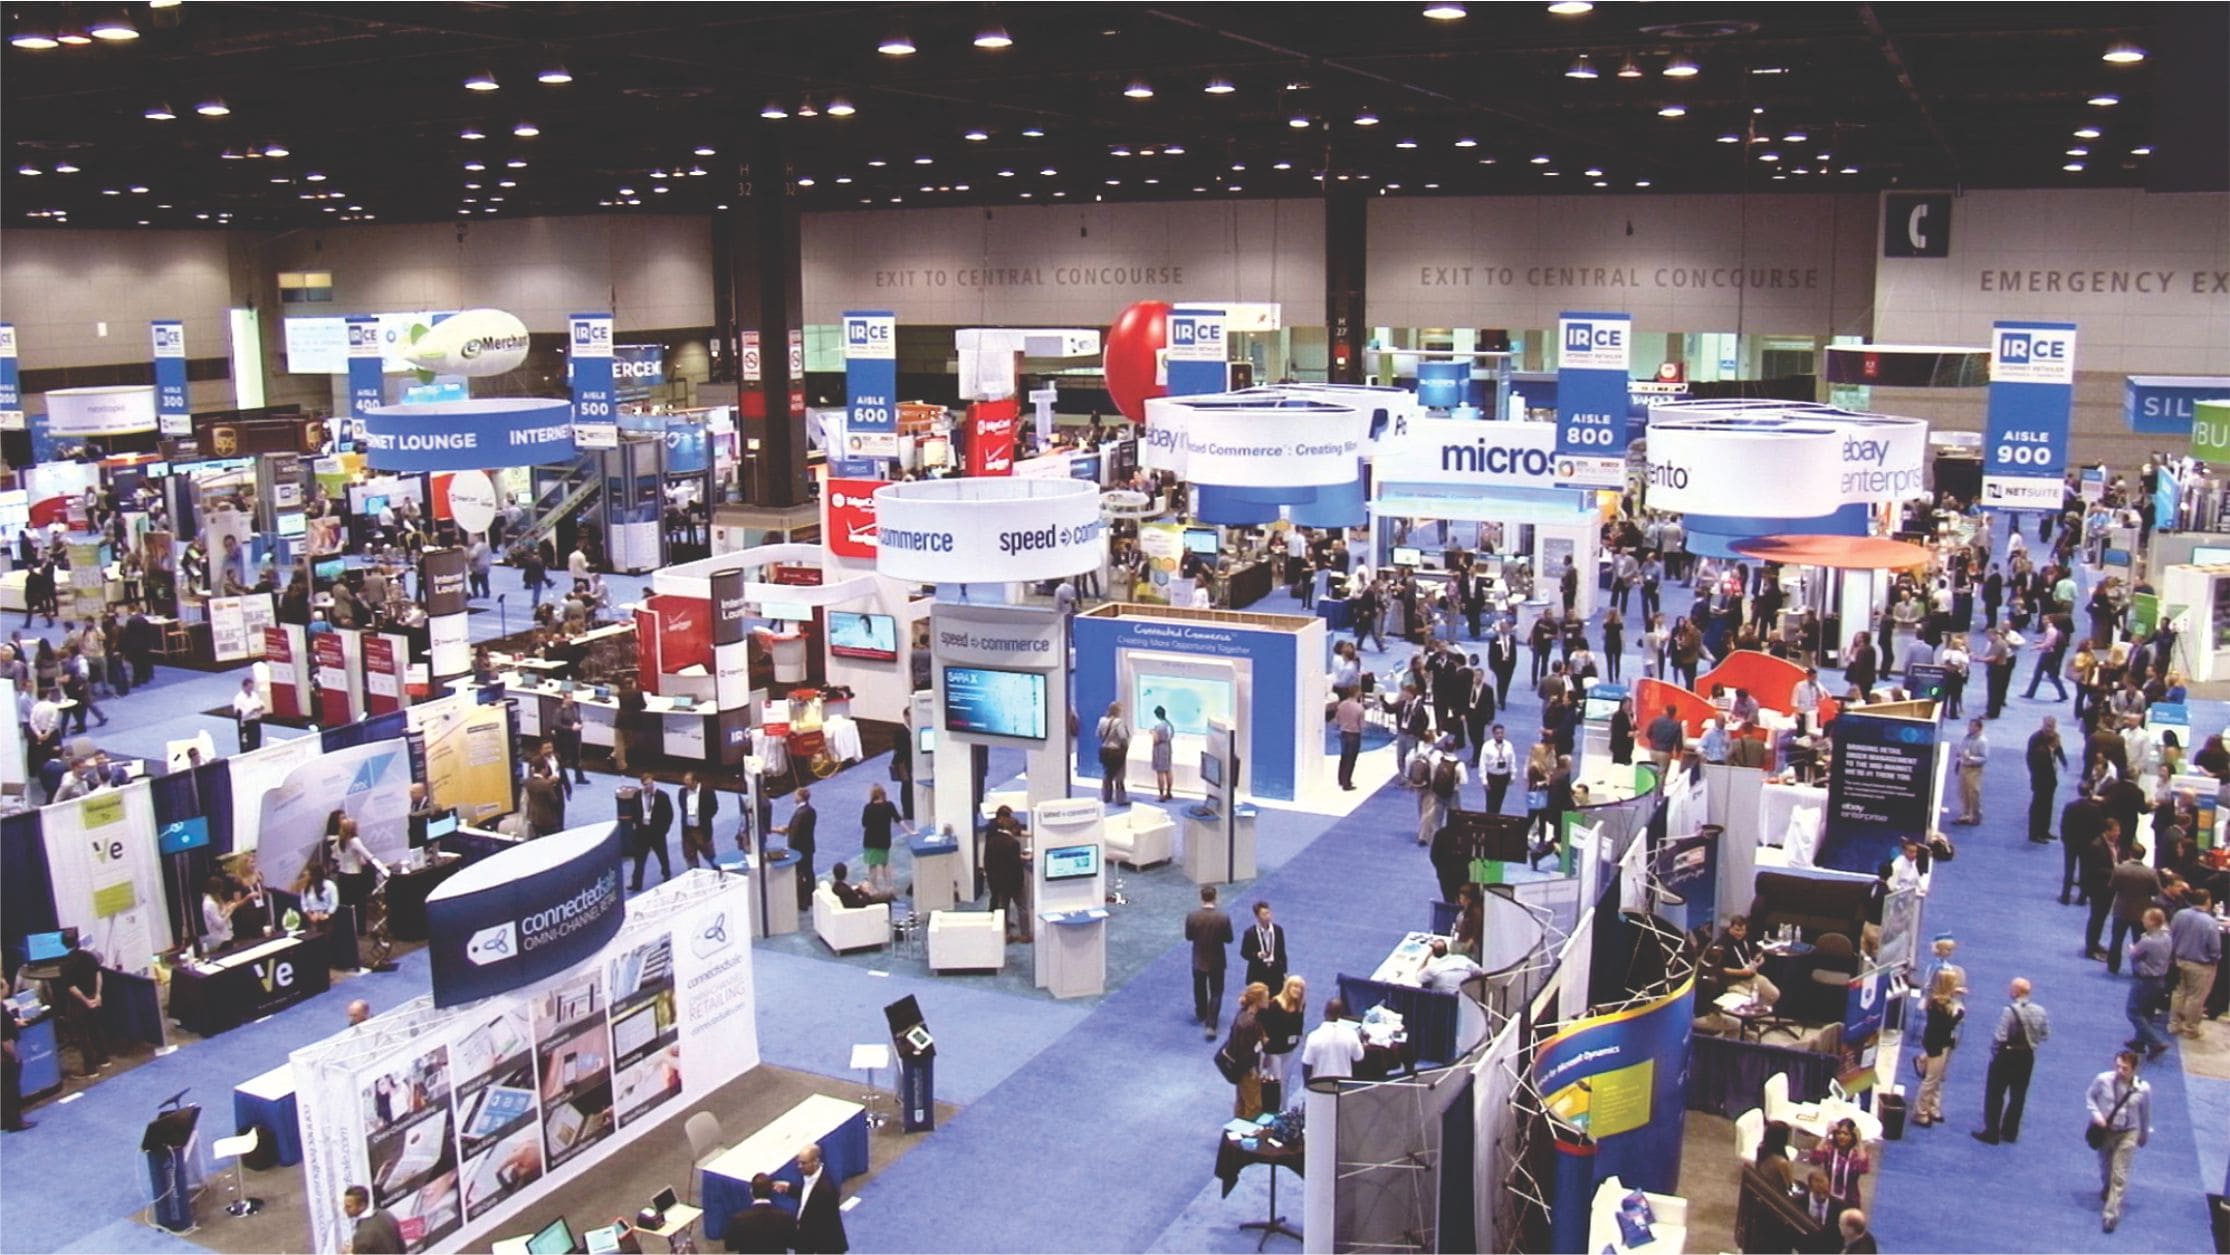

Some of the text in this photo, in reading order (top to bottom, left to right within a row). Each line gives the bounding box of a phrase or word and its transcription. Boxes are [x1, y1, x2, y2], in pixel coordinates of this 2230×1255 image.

[876, 266, 1184, 288] EXIT TO CENTRAL CONCOURSE
[1421, 267, 1819, 289] EXIT TO CENTRAL CONCOURSE
[1980, 270, 2175, 293] EMERGENCY
[575, 323, 608, 344] IRCE
[849, 321, 888, 344] IRCE
[1173, 320, 1221, 344] IRCE
[1566, 325, 1623, 350] IRCE
[2000, 335, 2065, 362] IRCE
[163, 396, 184, 407] 300
[583, 392, 606, 400] AISLE
[856, 396, 886, 406] AISLE
[581, 403, 609, 416] 500
[853, 408, 888, 424] 600
[1571, 413, 1611, 425] AISLE
[400, 432, 478, 450] LOUNGE
[1566, 427, 1614, 445] 800
[2003, 430, 2049, 443] AISLE
[1997, 445, 2052, 466] 900
[2005, 488, 2060, 498] NETSUITE
[999, 523, 1056, 557] speed
[940, 631, 1050, 653] speed commerce
[1116, 634, 1148, 648] Creating
[1171, 639, 1217, 653] Opportunity
[1217, 643, 1250, 655] Together
[1841, 803, 1865, 813] ebay
[92, 837, 124, 865] Ve
[253, 957, 295, 993] Ve
